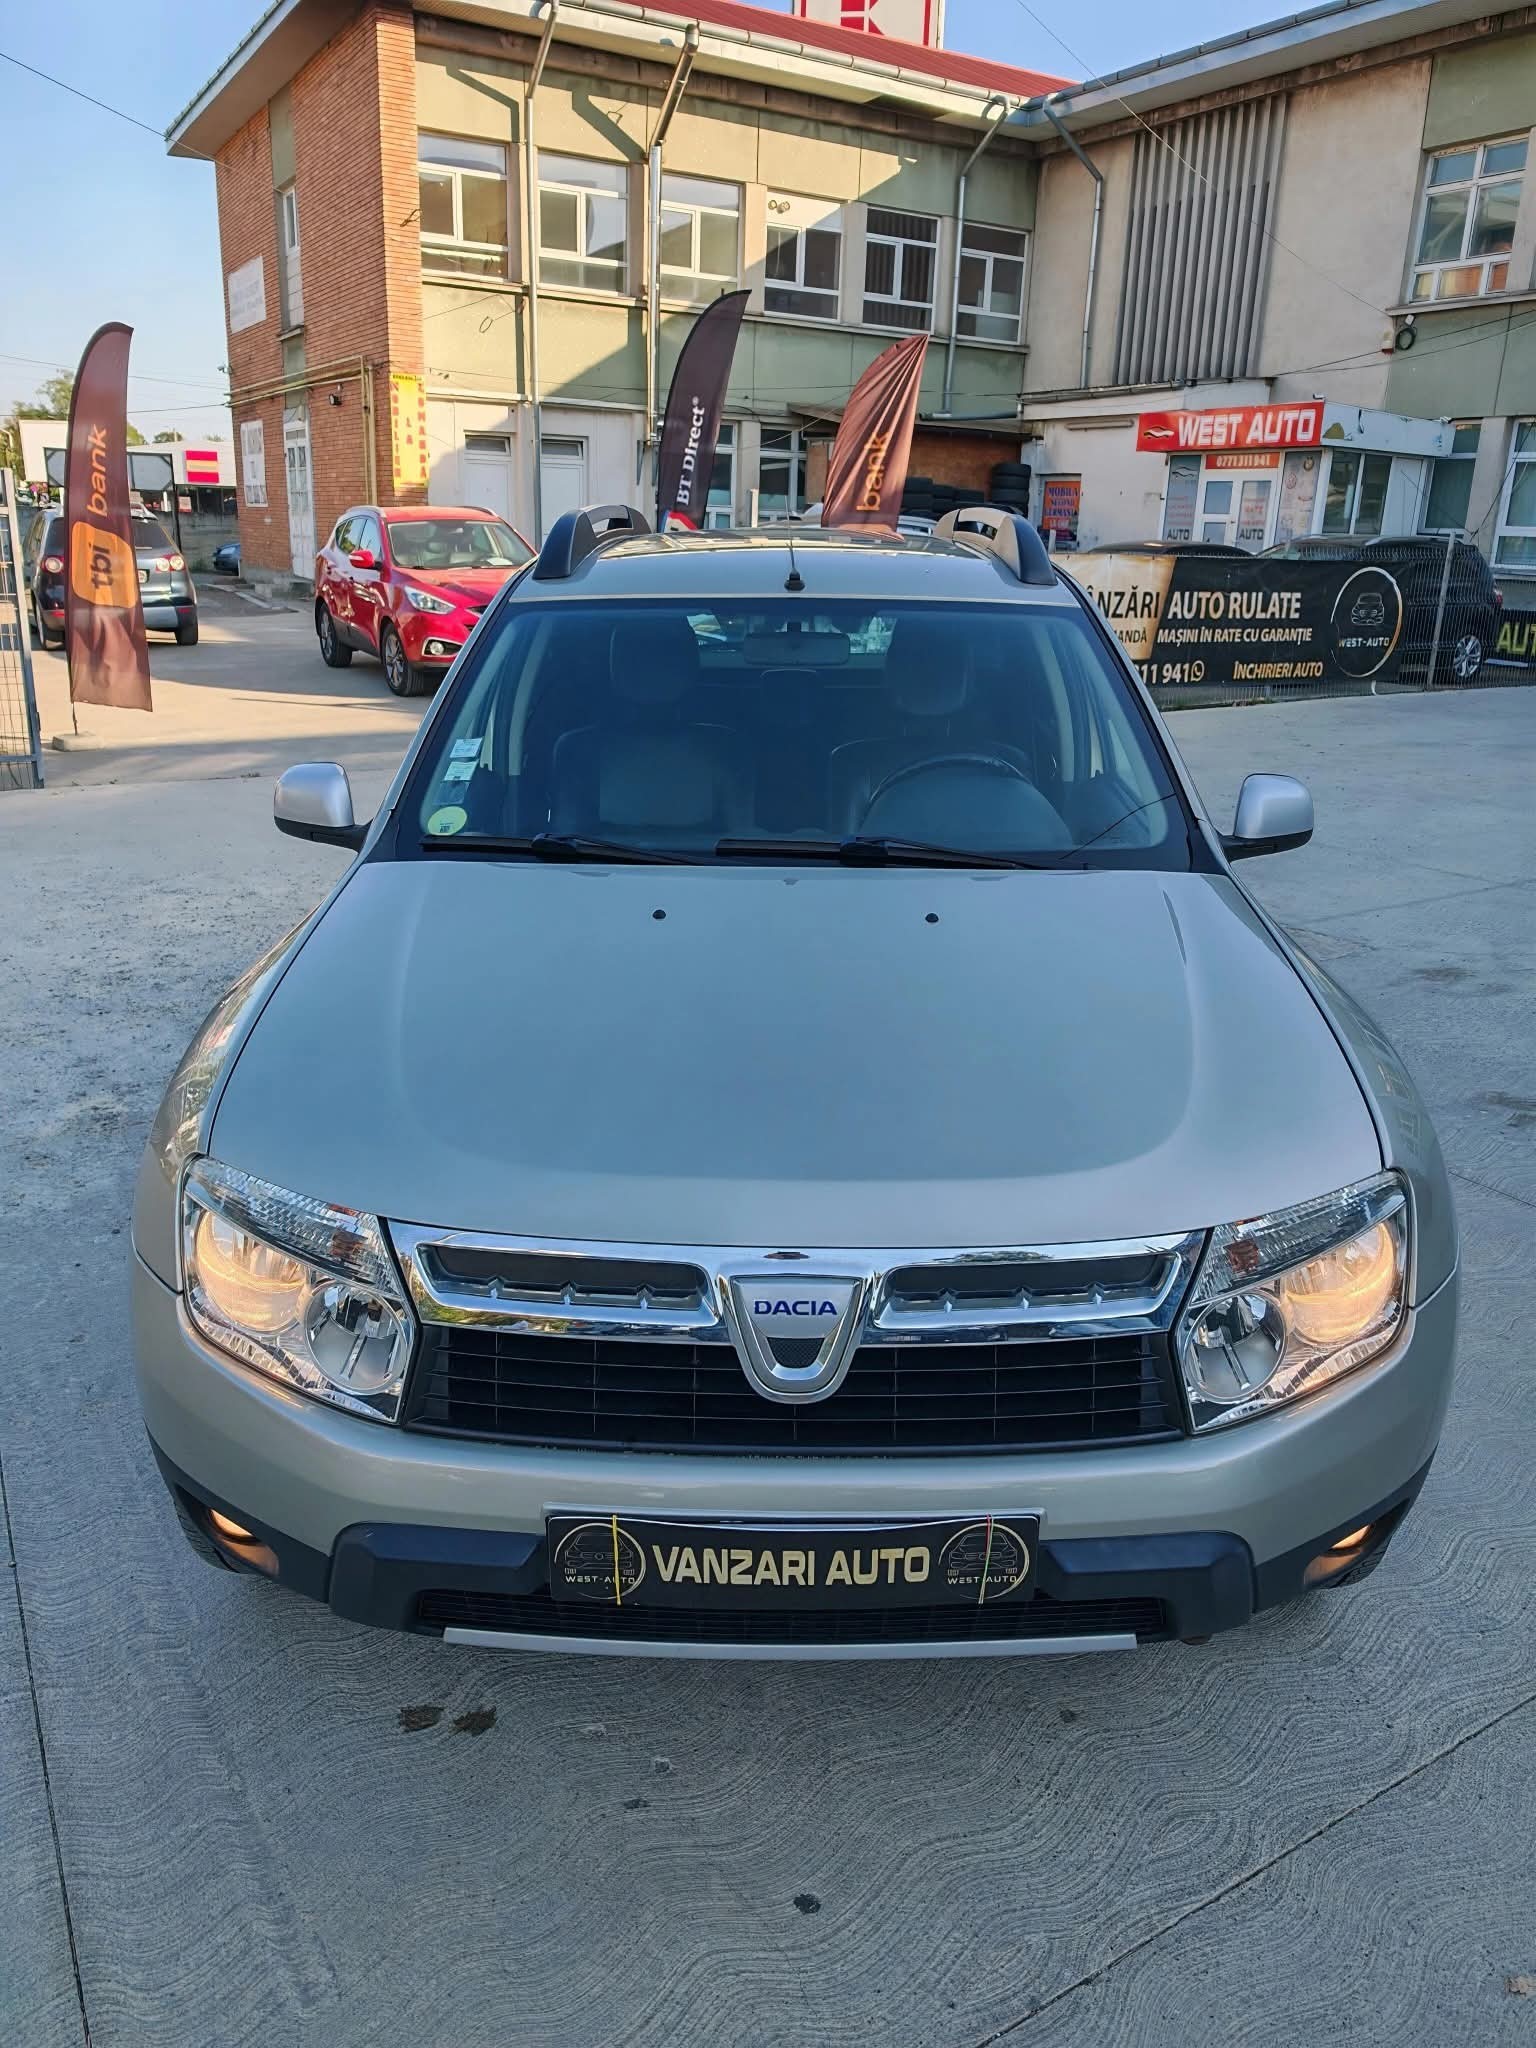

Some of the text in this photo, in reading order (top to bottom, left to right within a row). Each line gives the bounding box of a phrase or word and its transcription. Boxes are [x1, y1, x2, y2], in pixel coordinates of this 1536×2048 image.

[1179, 409, 1316, 447] WEST AUTO
[856, 430, 889, 512] bank
[677, 475, 692, 506] BT
[87, 424, 115, 590] tbi bank
[1166, 529, 1190, 541] AUTO
[1239, 528, 1264, 540] AUTO
[1168, 591, 1224, 620] AUTO
[1227, 592, 1301, 619] RULATE
[1214, 628, 1241, 643] RATE
[1243, 628, 1258, 642] CU
[1338, 637, 1390, 648] WEST-AUTO
[1162, 661, 1191, 684] 941
[1232, 661, 1323, 680] ÎNCHIRIERI AUTO
[754, 1300, 838, 1316] DACIA
[652, 1545, 930, 1587] VANZARI AUTO
[565, 1575, 636, 1585] WEST-ATO
